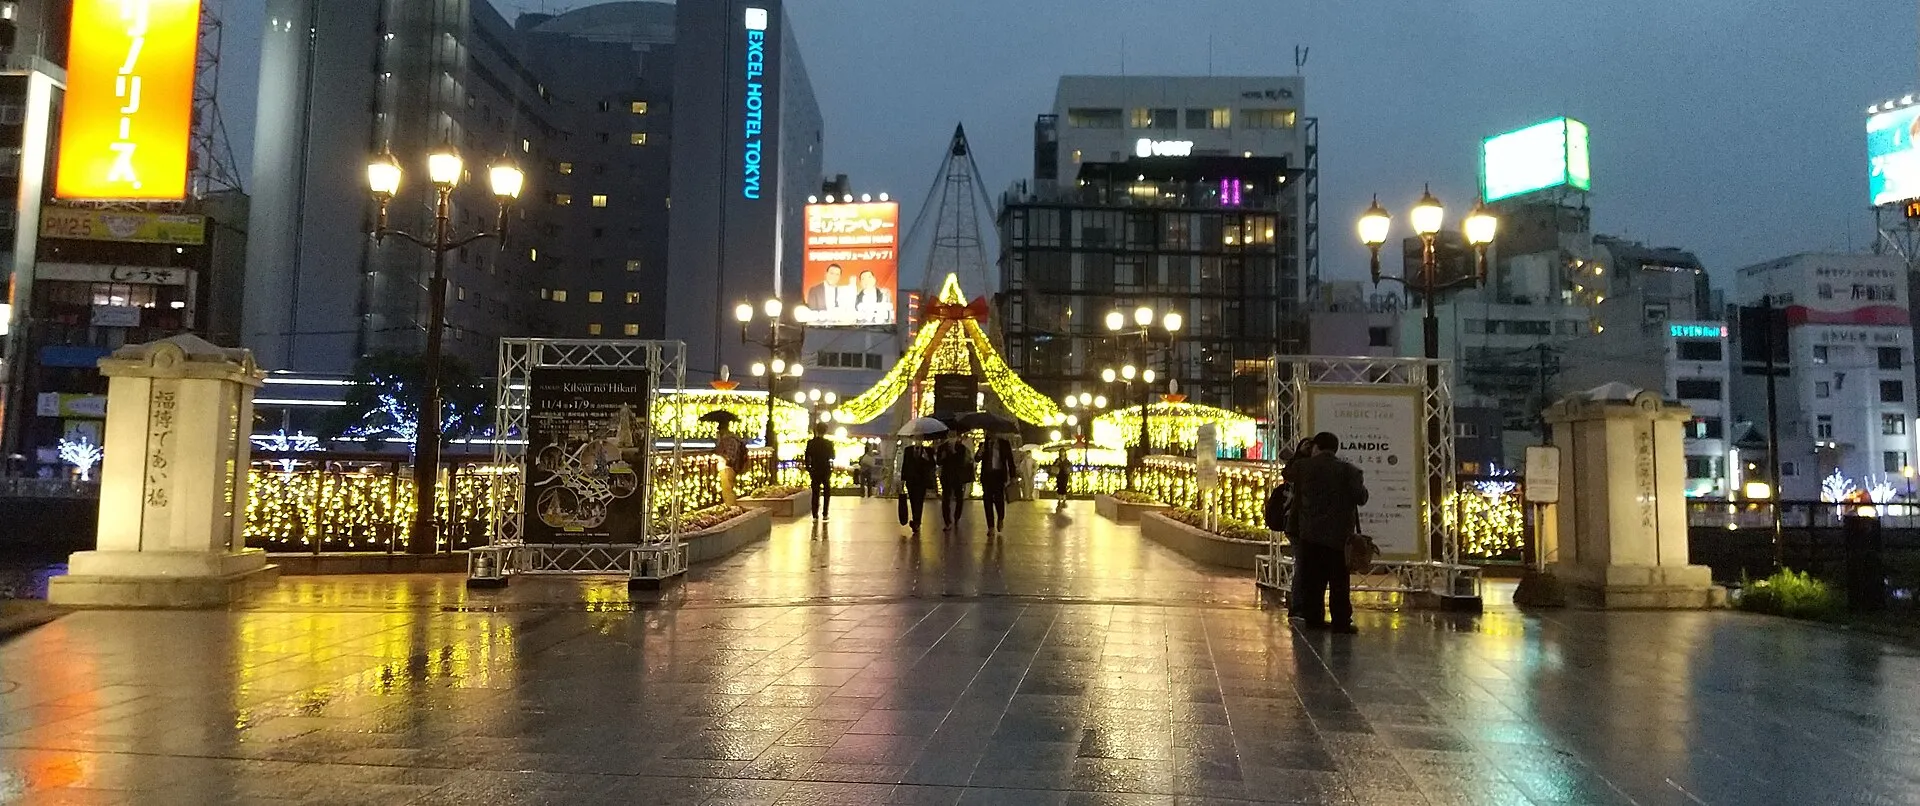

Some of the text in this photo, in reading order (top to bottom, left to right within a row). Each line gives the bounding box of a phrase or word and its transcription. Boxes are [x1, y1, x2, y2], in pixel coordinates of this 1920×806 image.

[743, 30, 764, 199] EXCEL HOTEL TOKYU
[45, 218, 92, 236] PM2.5
[608, 383, 638, 393] Hikari
[541, 400, 562, 409] 11/4
[574, 400, 590, 409] 1/9
[1340, 442, 1389, 451] LANDIC
